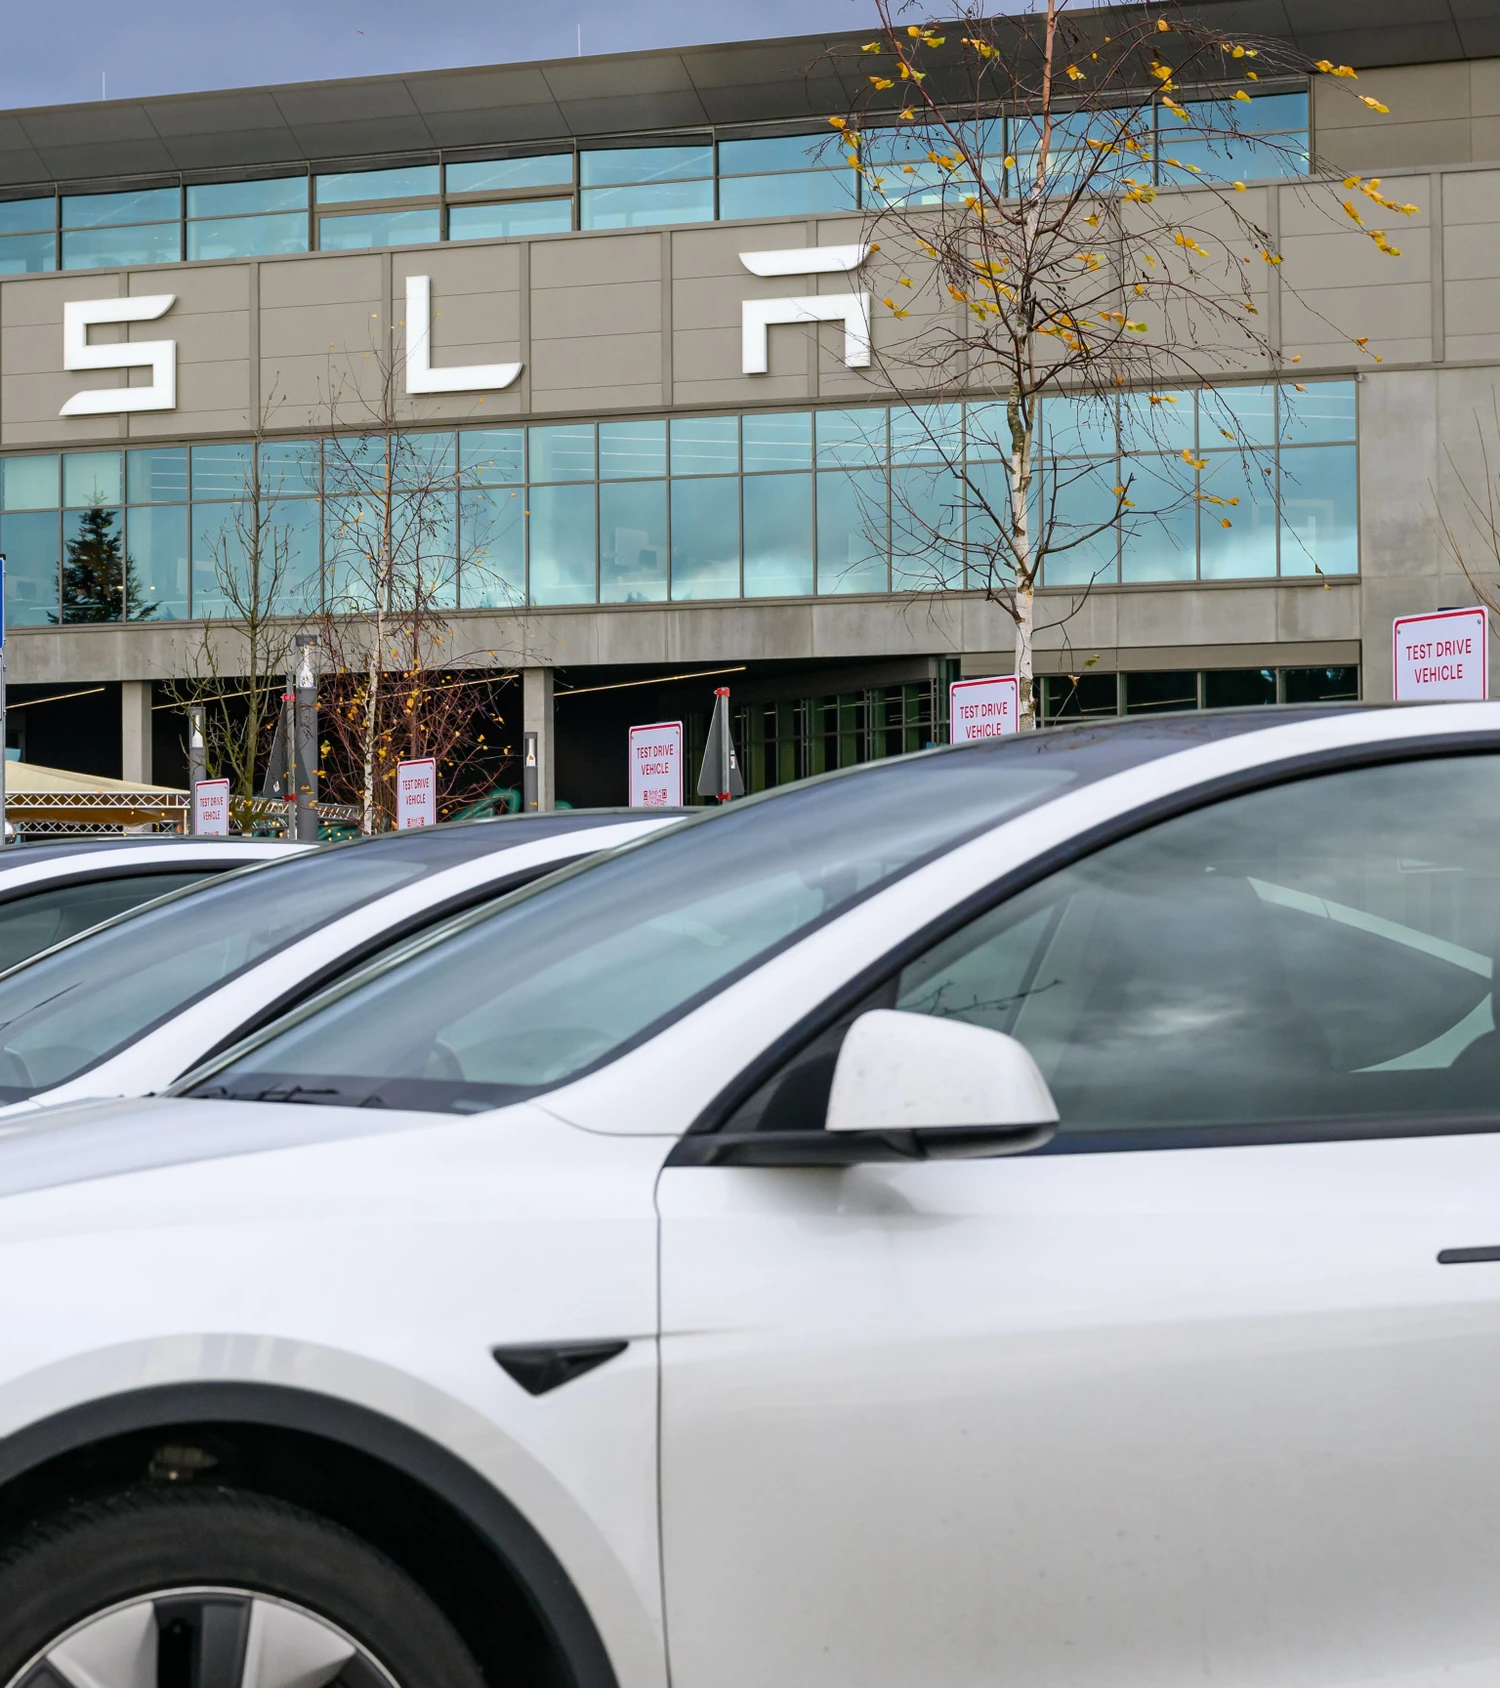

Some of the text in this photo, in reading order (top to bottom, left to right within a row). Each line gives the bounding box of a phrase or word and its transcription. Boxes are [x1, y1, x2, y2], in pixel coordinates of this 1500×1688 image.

[1406, 638, 1472, 661] TEST DRIVE
[1414, 663, 1463, 684] VEHICLE
[960, 702, 1008, 719] TEST DRIVE
[966, 723, 1001, 739] VEHICLE
[636, 744, 674, 759] TEST DRIVE
[641, 762, 669, 776] VEHICLE
[402, 777, 429, 790] TEST DRIVE
[199, 796, 223, 807] TEST DRIVE
[405, 794, 426, 805] VEHICLE
[202, 810, 221, 820] VEHICLE
